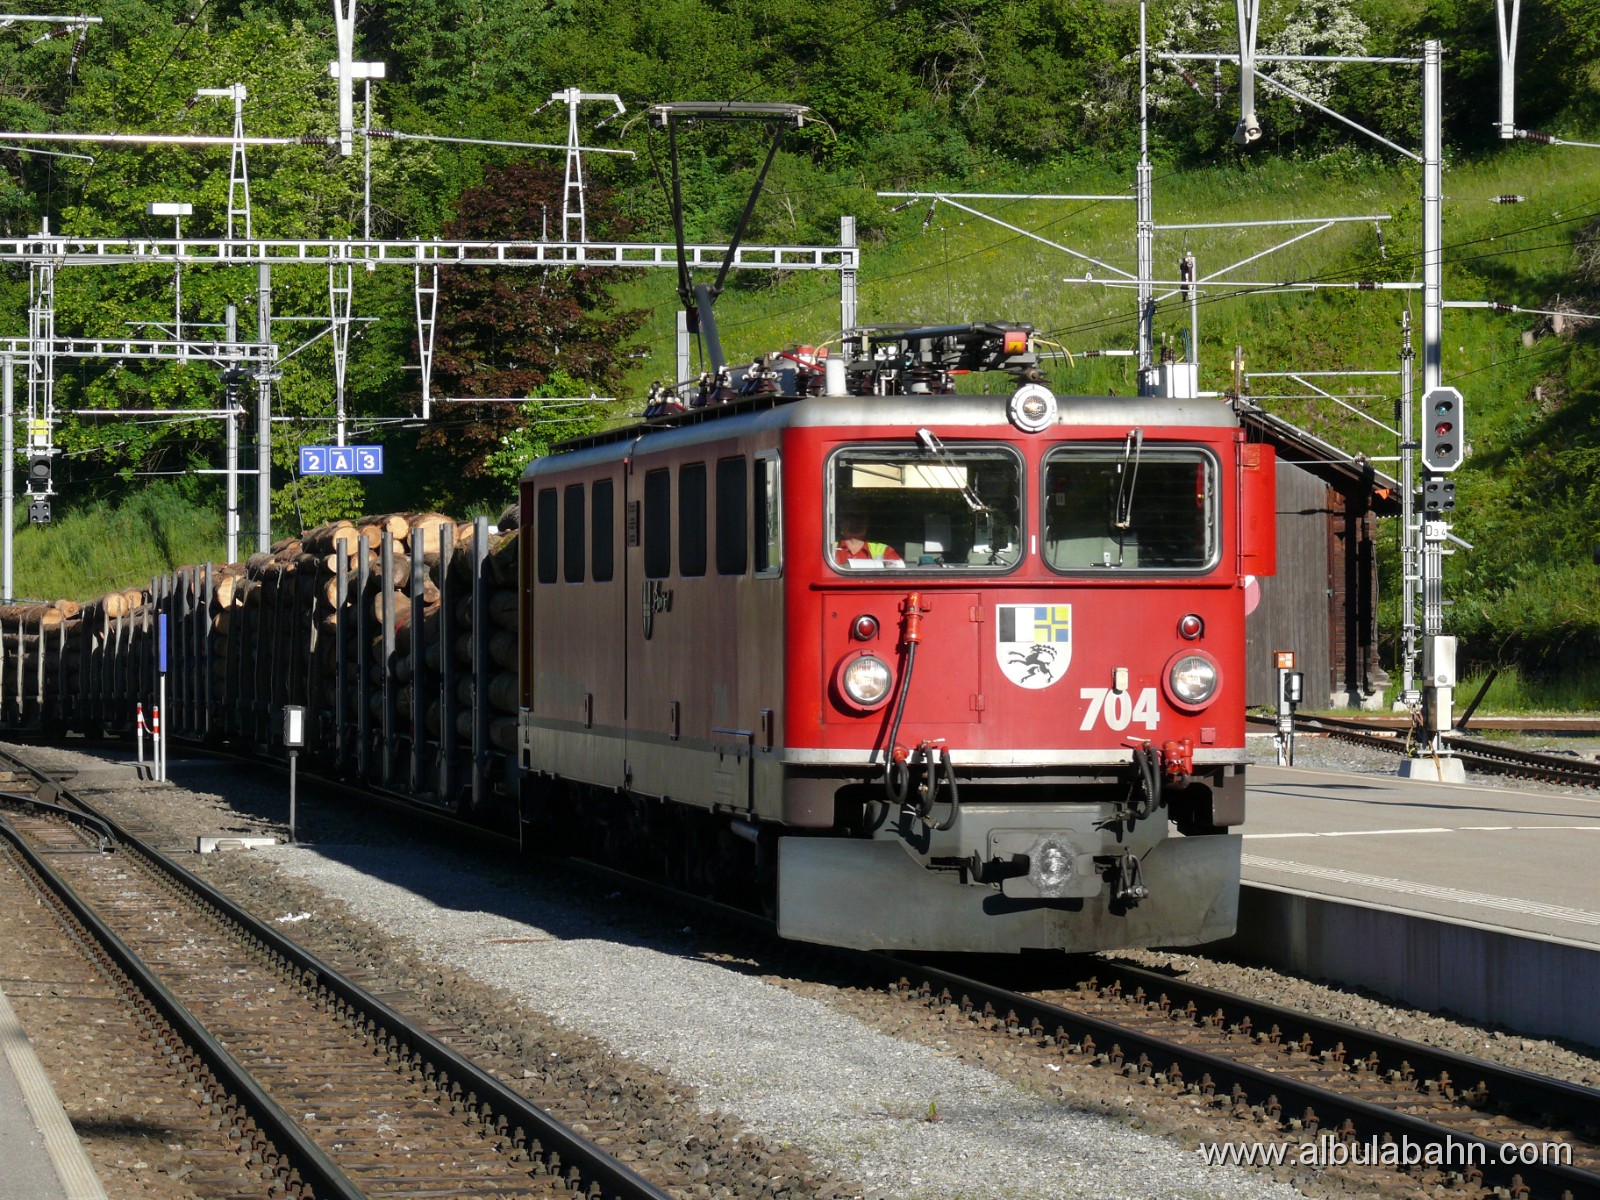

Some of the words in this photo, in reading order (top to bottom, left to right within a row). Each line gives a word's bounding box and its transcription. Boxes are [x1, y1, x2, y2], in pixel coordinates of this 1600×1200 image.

[308, 455, 320, 470] 2
[335, 455, 348, 470] A
[363, 454, 375, 469] 3
[1079, 687, 1160, 731] 704
